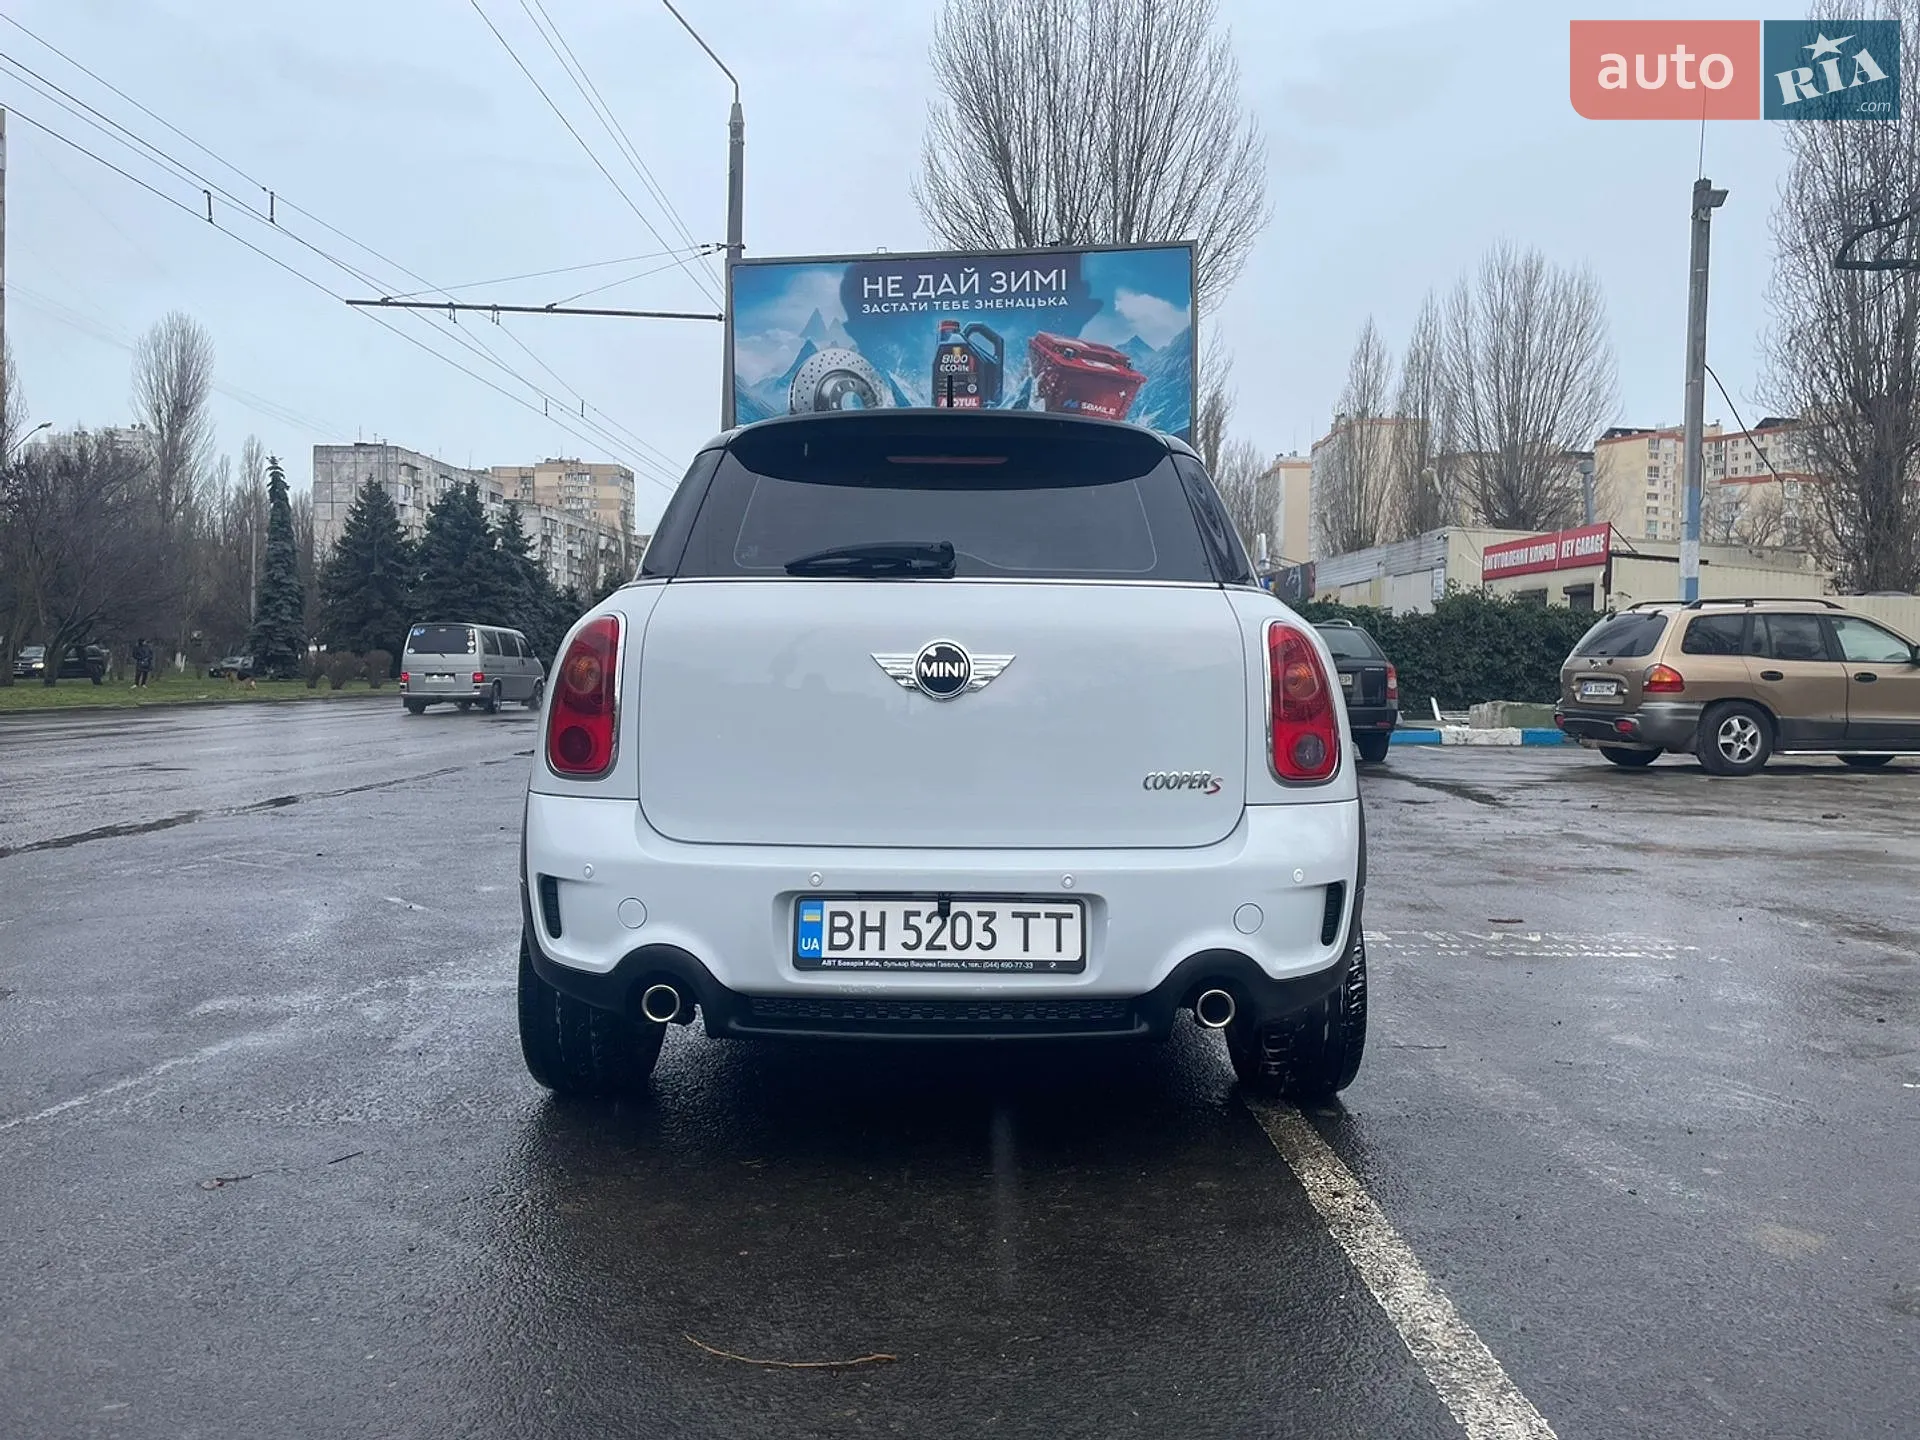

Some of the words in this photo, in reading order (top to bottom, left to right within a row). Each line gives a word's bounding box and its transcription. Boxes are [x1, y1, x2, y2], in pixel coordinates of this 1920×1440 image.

[863, 275, 904, 298] НЕ
[912, 267, 980, 300] ДАЙ
[990, 268, 1067, 294] ЗИМІ
[862, 301, 928, 314] ЗАСТАТИ
[933, 300, 970, 311] ТЕБЕ
[975, 296, 1068, 309] ЗНЕНАЦЬКА
[941, 353, 968, 364] 8100
[920, 661, 966, 679] MINI
[828, 910, 886, 951] BH
[901, 910, 997, 951] 5203
[1011, 911, 1074, 952] TT
[802, 938, 820, 951] UA
